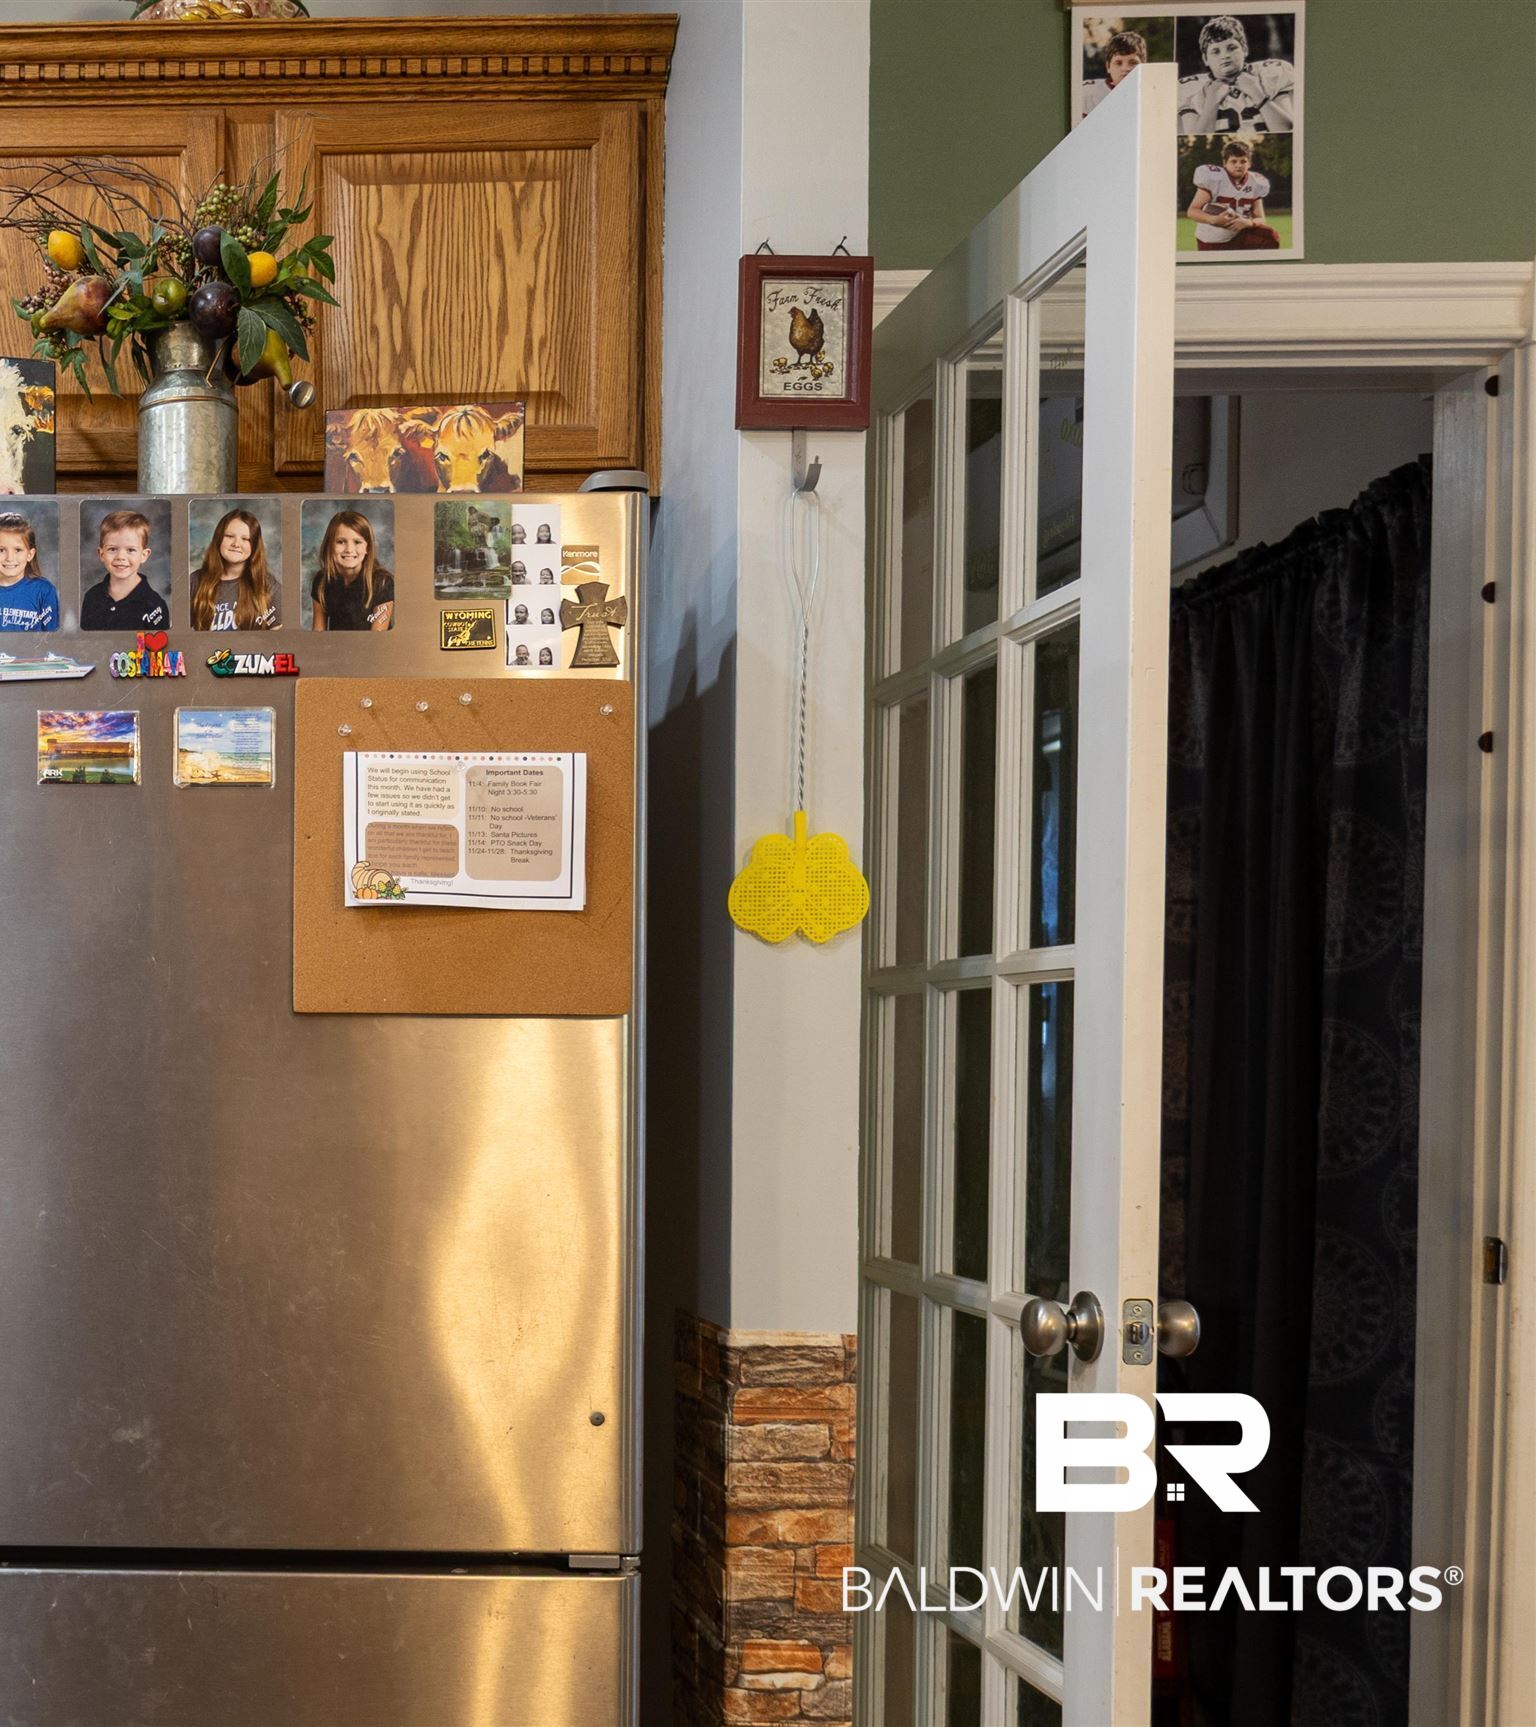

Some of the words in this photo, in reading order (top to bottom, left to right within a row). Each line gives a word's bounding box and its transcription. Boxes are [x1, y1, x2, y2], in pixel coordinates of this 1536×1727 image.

[767, 288, 799, 312] Farm
[804, 286, 842, 311] Fresh
[783, 382, 823, 392] EGGS
[562, 550, 598, 558] Kenmore
[445, 611, 491, 620] WYOMING
